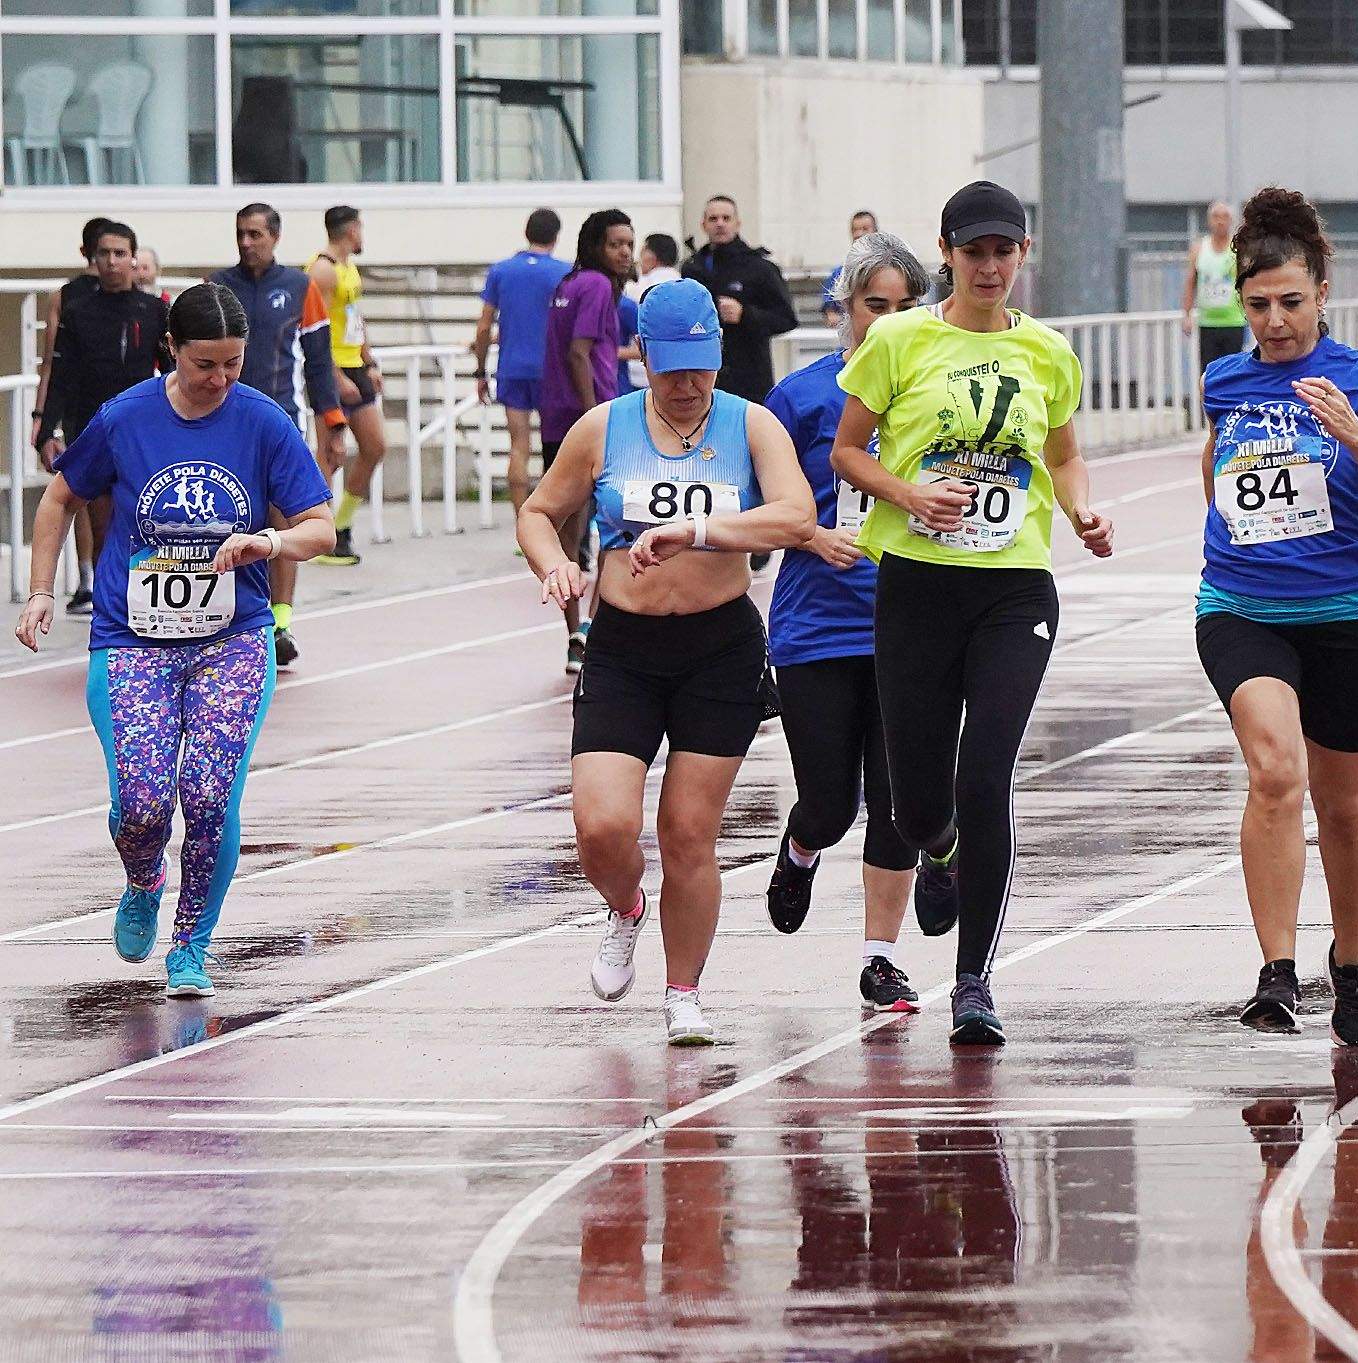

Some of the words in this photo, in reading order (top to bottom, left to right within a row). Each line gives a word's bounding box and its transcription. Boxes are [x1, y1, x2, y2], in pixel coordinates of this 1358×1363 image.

[991, 360, 1000, 373] O
[1237, 443, 1250, 457] XI
[1252, 438, 1293, 456] MILLA
[954, 450, 970, 464] XI
[971, 452, 1007, 472] MILLA
[1252, 457, 1272, 470] POLA
[1273, 453, 1310, 467] DIABETES
[985, 472, 1020, 487] DIABETES
[1236, 468, 1299, 511] 84
[173, 466, 206, 478] POLA
[210, 468, 248, 517] DIABETES
[648, 482, 713, 519] 80
[929, 476, 1010, 523] 30
[157, 545, 169, 560] XI
[172, 545, 210, 560] MILLA
[169, 562, 189, 572] POLA
[190, 562, 214, 572] DIABE
[141, 573, 219, 609] 107
